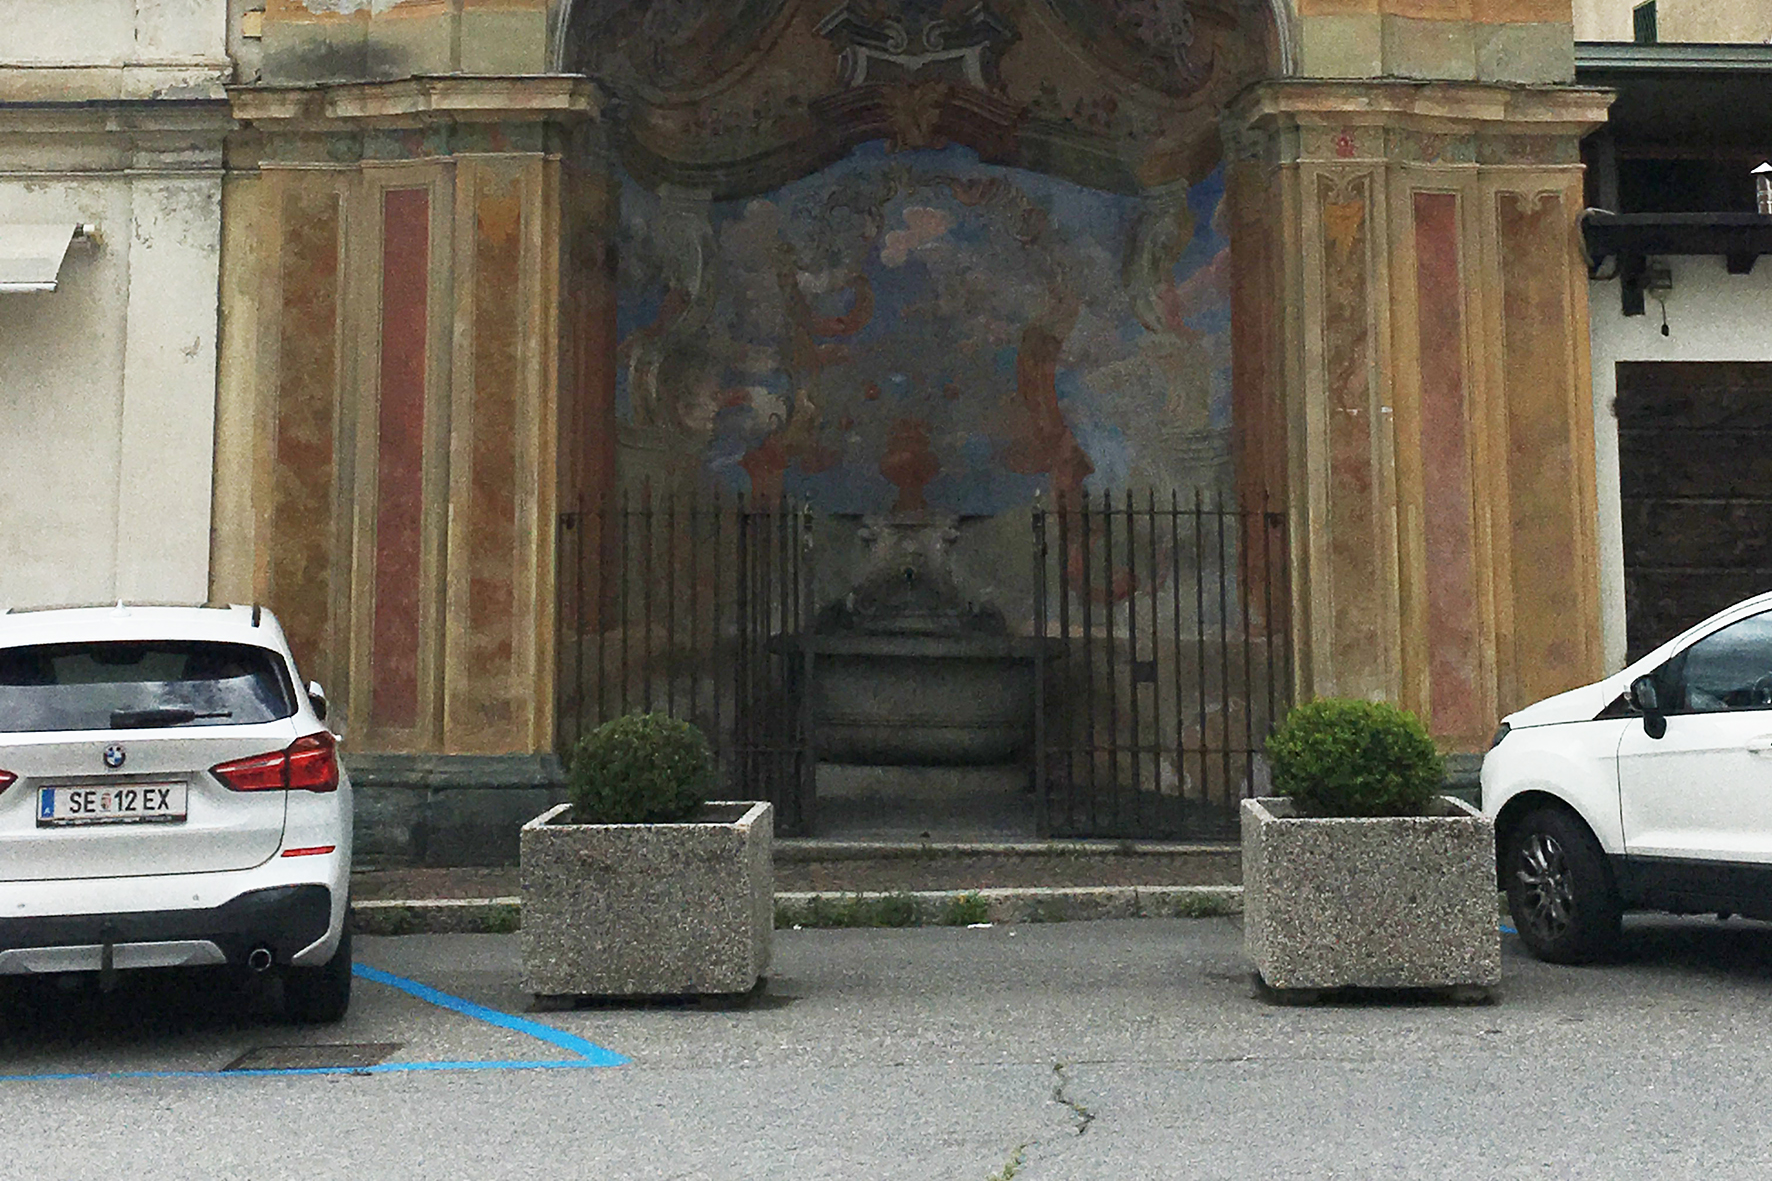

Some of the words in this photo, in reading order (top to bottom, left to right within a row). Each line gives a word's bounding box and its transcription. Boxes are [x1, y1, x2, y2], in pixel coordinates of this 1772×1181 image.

[69, 791, 97, 814] SE
[114, 789, 138, 812] 12
[143, 788, 170, 811] EX
